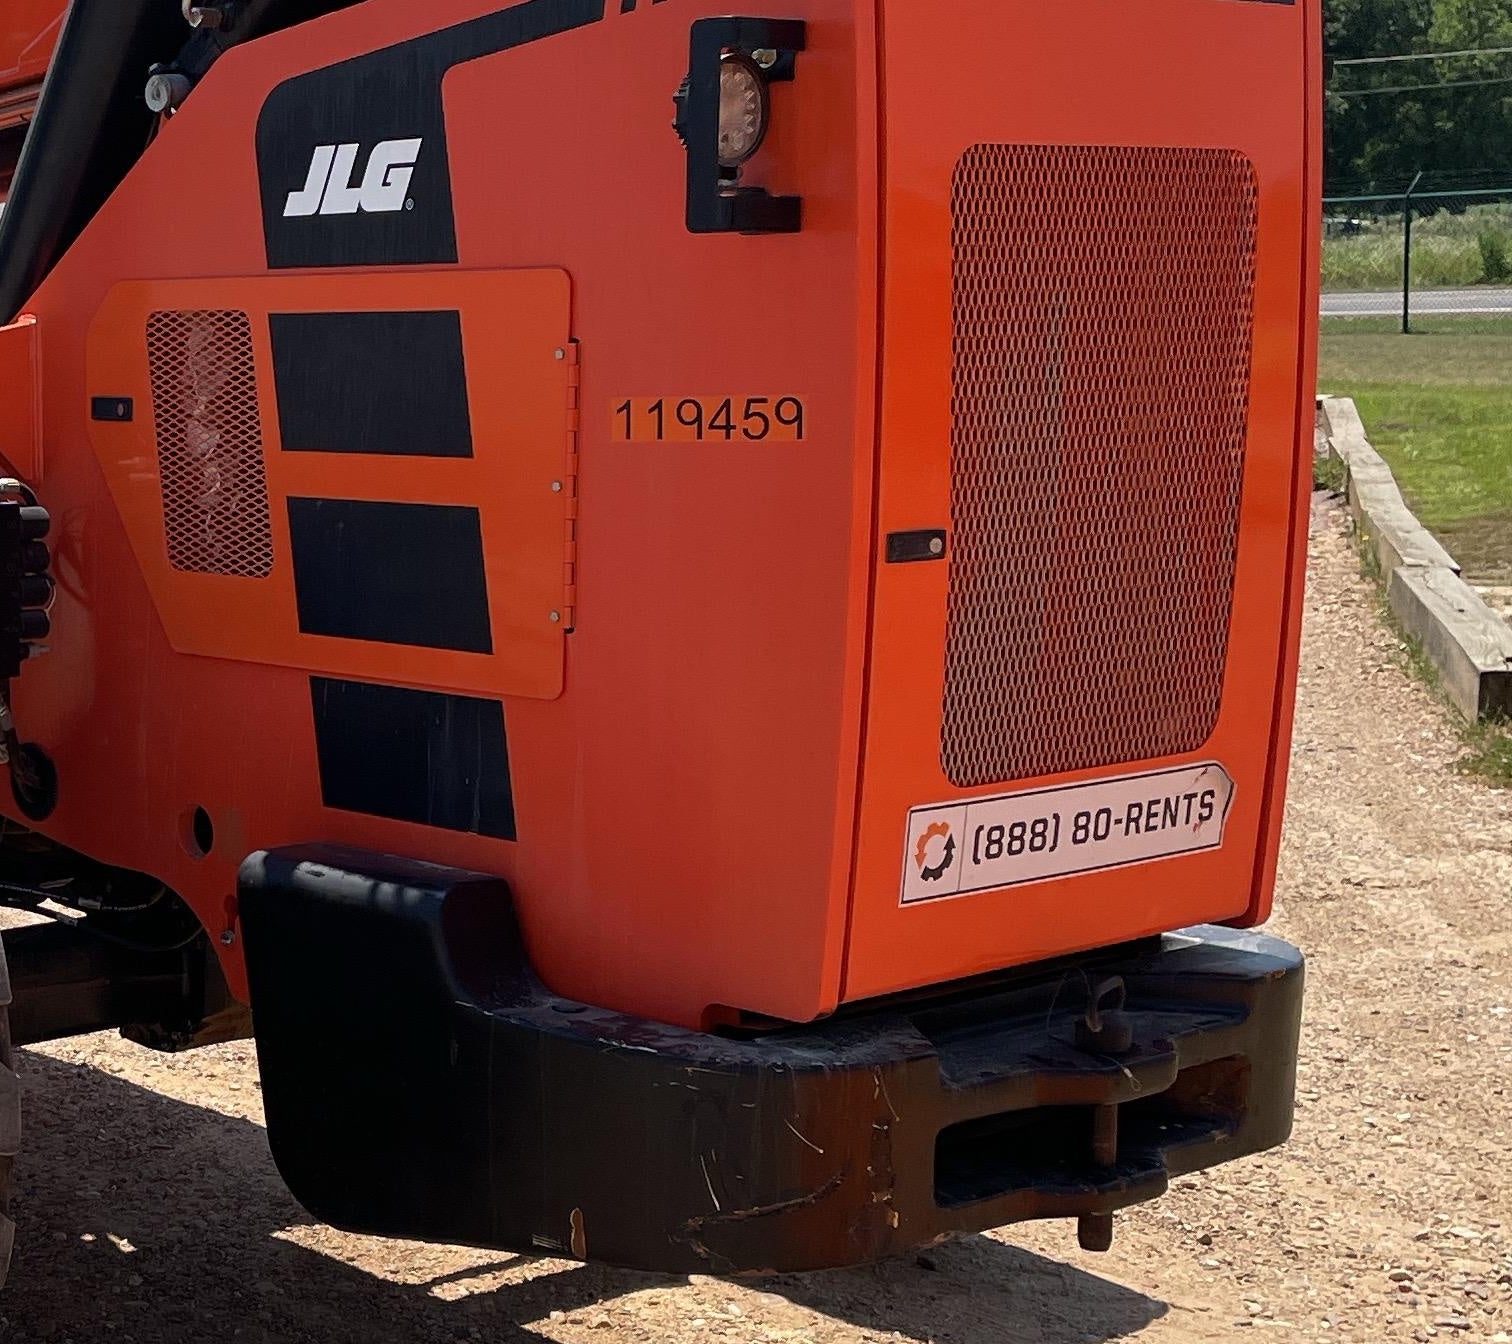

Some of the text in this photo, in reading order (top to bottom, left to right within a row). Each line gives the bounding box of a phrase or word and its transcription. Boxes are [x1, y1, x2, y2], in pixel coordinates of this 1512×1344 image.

[283, 137, 423, 217] JLG
[616, 396, 803, 441] 119459
[972, 788, 1216, 865] (888) 80-RENTS
